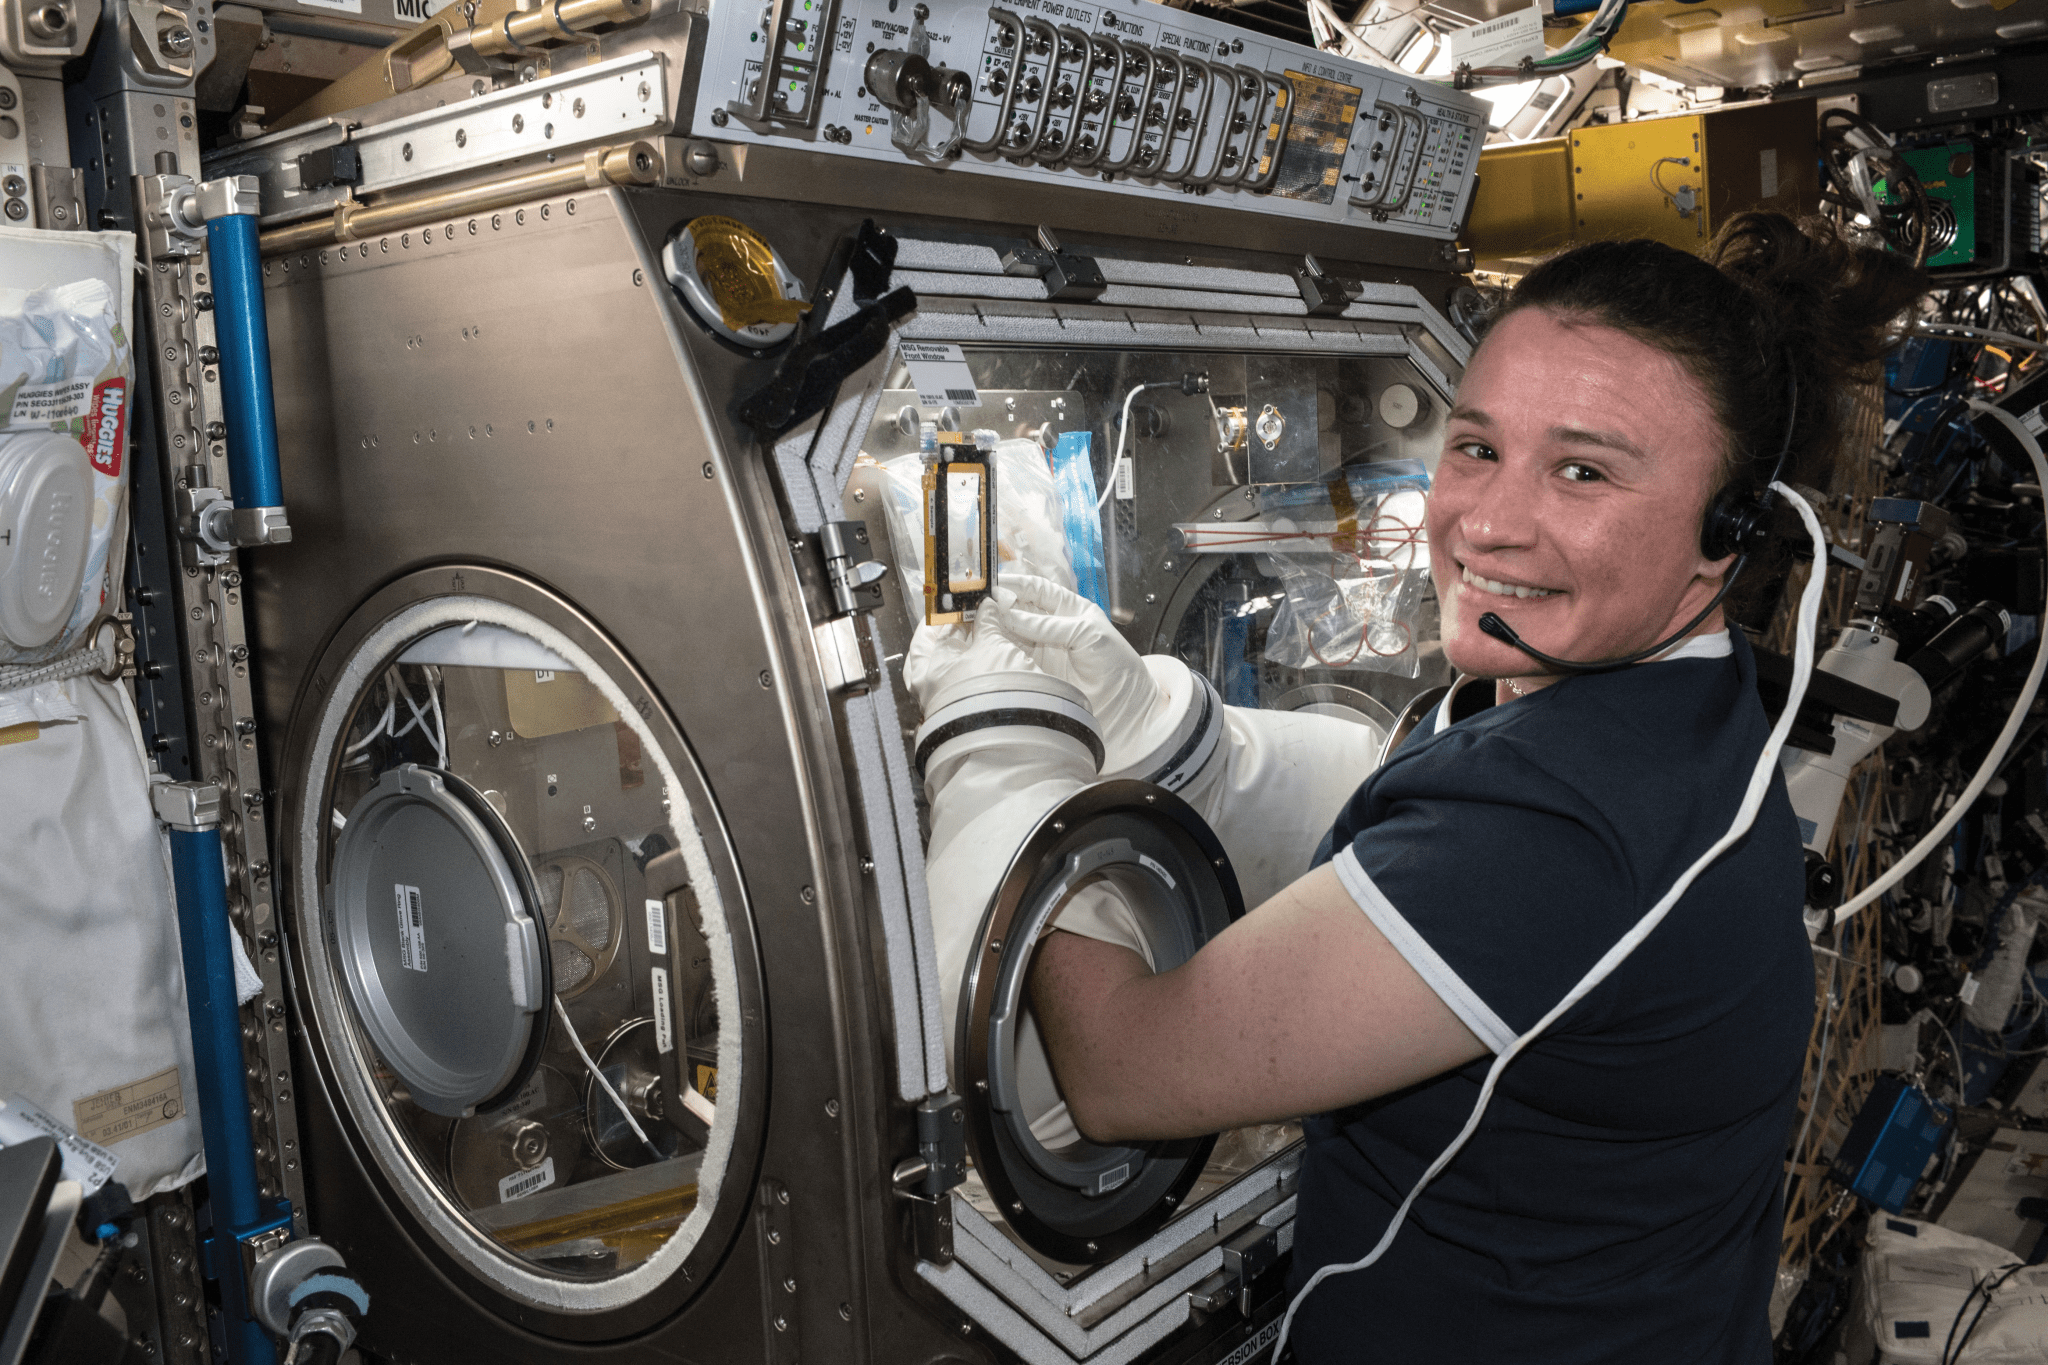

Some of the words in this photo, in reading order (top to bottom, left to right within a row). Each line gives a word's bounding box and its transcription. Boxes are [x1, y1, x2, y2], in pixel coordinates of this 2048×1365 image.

[1042, 1, 1064, 16] POWER
[1066, 7, 1092, 23] OUTLETS
[843, 21, 852, 29] +5V
[1114, 20, 1144, 36] FUNCTIONS
[840, 31, 852, 40] +12V
[882, 31, 895, 41] TEST
[1161, 32, 1181, 46] SPECIAL
[1183, 41, 1211, 53] FUNCTIONS
[1302, 62, 1312, 70] INFO
[1317, 65, 1336, 79] CONTROL
[1337, 71, 1353, 83] CENTRE
[1093, 78, 1104, 87] MODE
[854, 114, 871, 123] MASTER
[871, 115, 889, 125] CAUTION
[1437, 107, 1451, 118] HEALTH
[1454, 112, 1470, 123] STATUS
[901, 343, 916, 351] MSG
[916, 344, 949, 353] Removable
[904, 352, 920, 360] Front
[921, 352, 945, 360] Window
[18, 390, 53, 400] HUGGIES
[70, 382, 90, 393] ASSY
[90, 394, 101, 417] Wipes
[14, 410, 27, 418] L/N
[95, 387, 124, 465] HUGGIES
[658, 997, 666, 1031] Loading
[88, 1172, 104, 1187] P2
[1260, 1321, 1280, 1346] BOX
